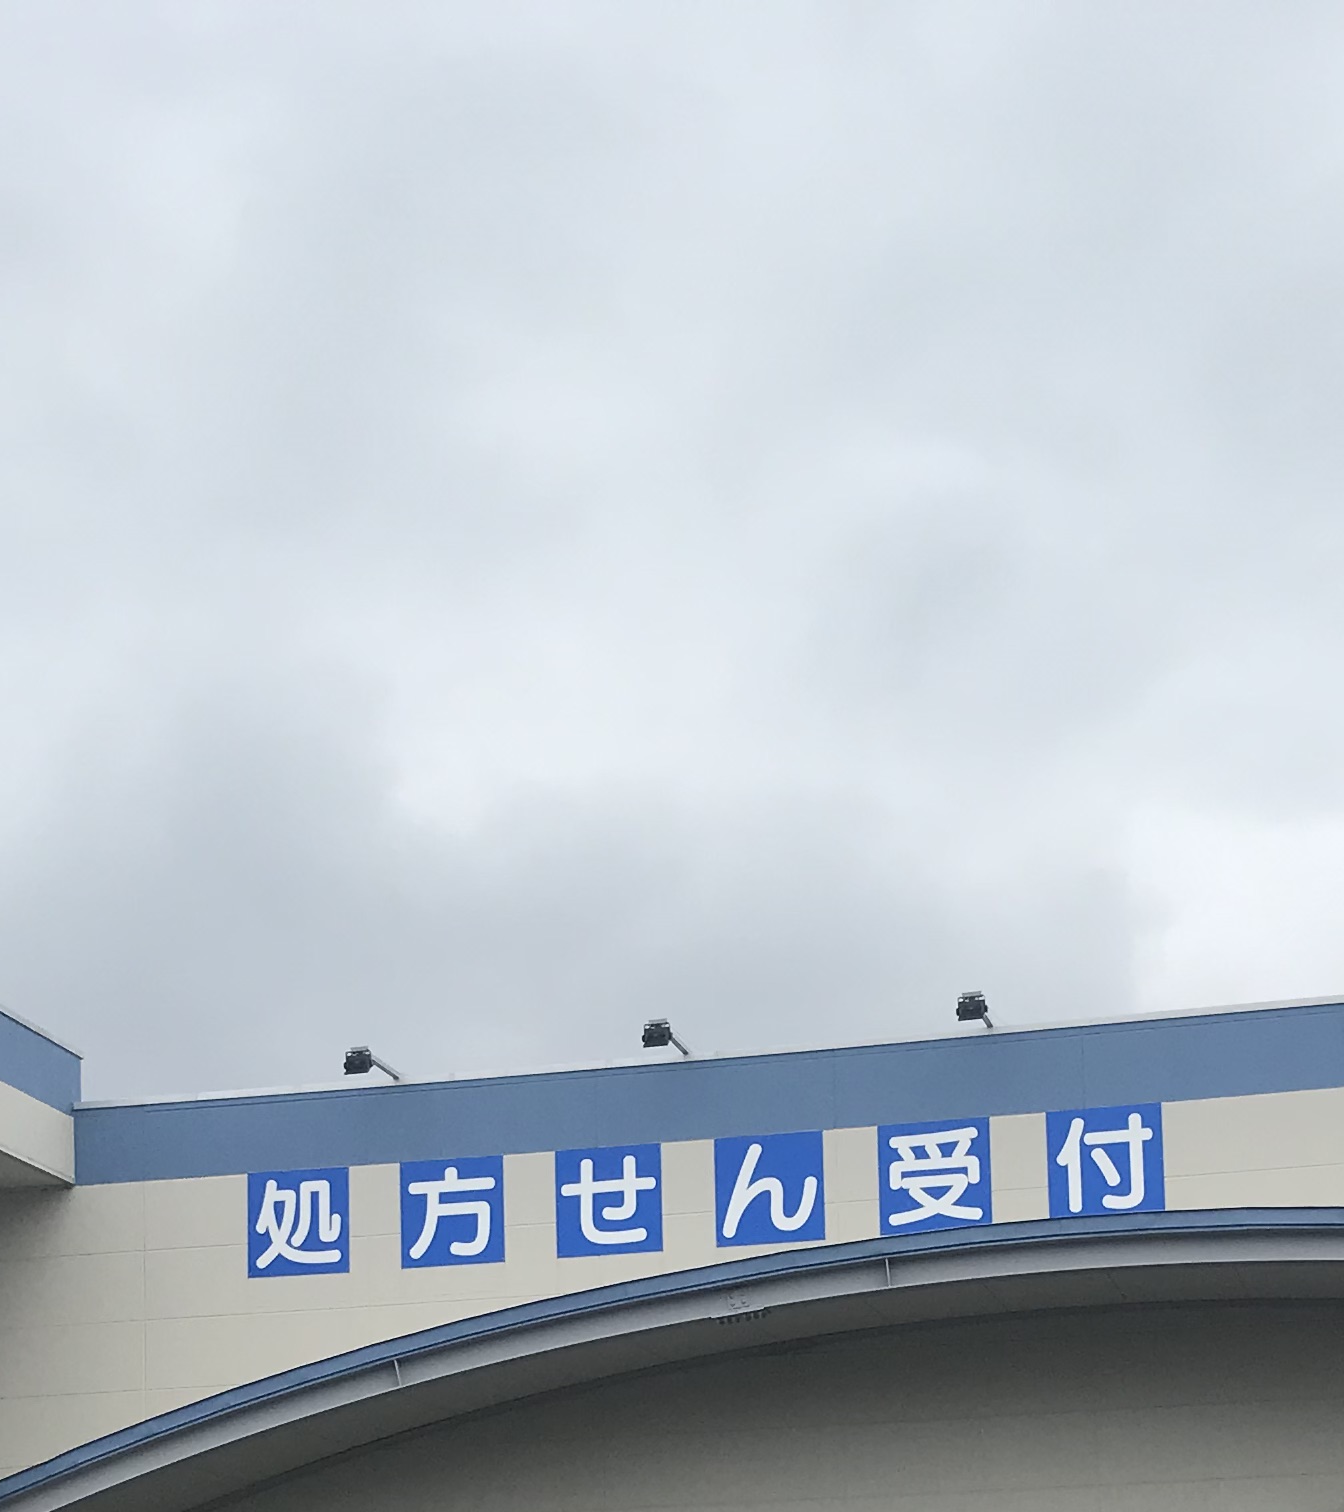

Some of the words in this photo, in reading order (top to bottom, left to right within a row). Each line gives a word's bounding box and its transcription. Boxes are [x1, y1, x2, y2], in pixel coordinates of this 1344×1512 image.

[256, 1112, 1154, 1271] 処方せん受付
